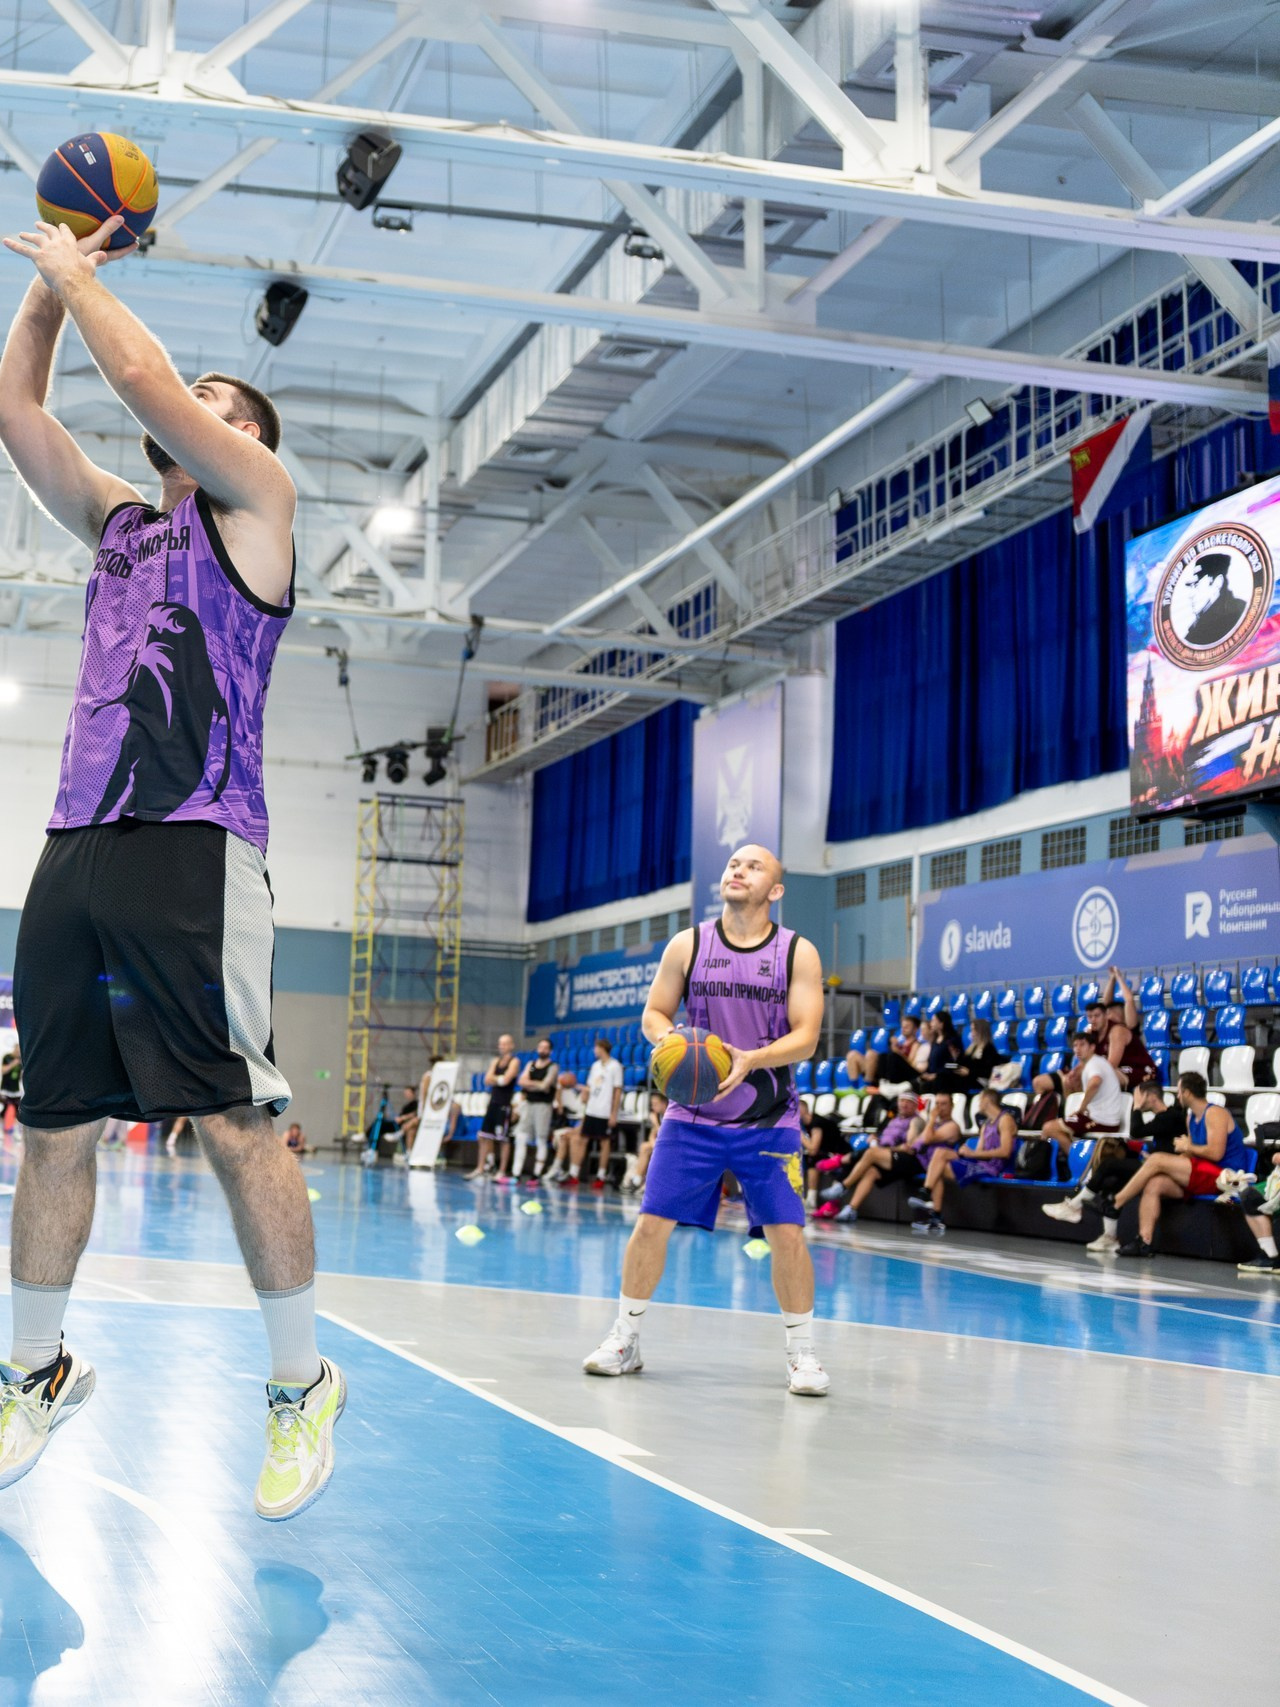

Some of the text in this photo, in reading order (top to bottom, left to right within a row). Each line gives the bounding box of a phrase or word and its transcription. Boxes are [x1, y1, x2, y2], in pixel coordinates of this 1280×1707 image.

[1219, 888, 1258, 905] Русская
[1219, 918, 1267, 935] Компания
[965, 921, 1011, 953] slavda
[702, 958, 731, 969] ЛДПР
[691, 980, 787, 1006] СОКОЛЫ ПРИМОРЬЯ
